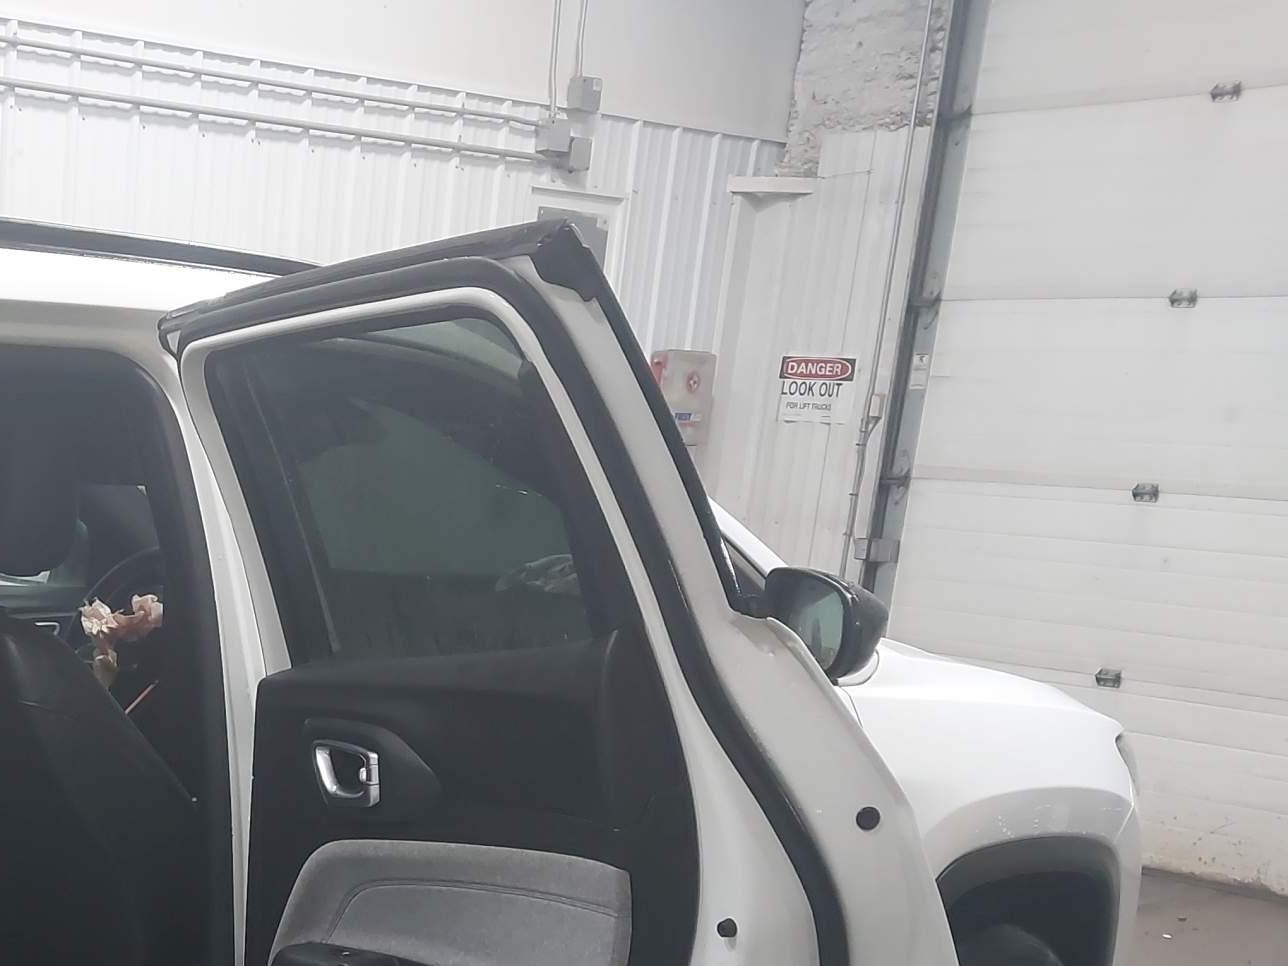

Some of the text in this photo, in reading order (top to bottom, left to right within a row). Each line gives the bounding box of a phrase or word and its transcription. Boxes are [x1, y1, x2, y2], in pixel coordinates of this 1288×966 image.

[787, 362, 842, 375] DANGER
[781, 381, 843, 397] LOOK OUT
